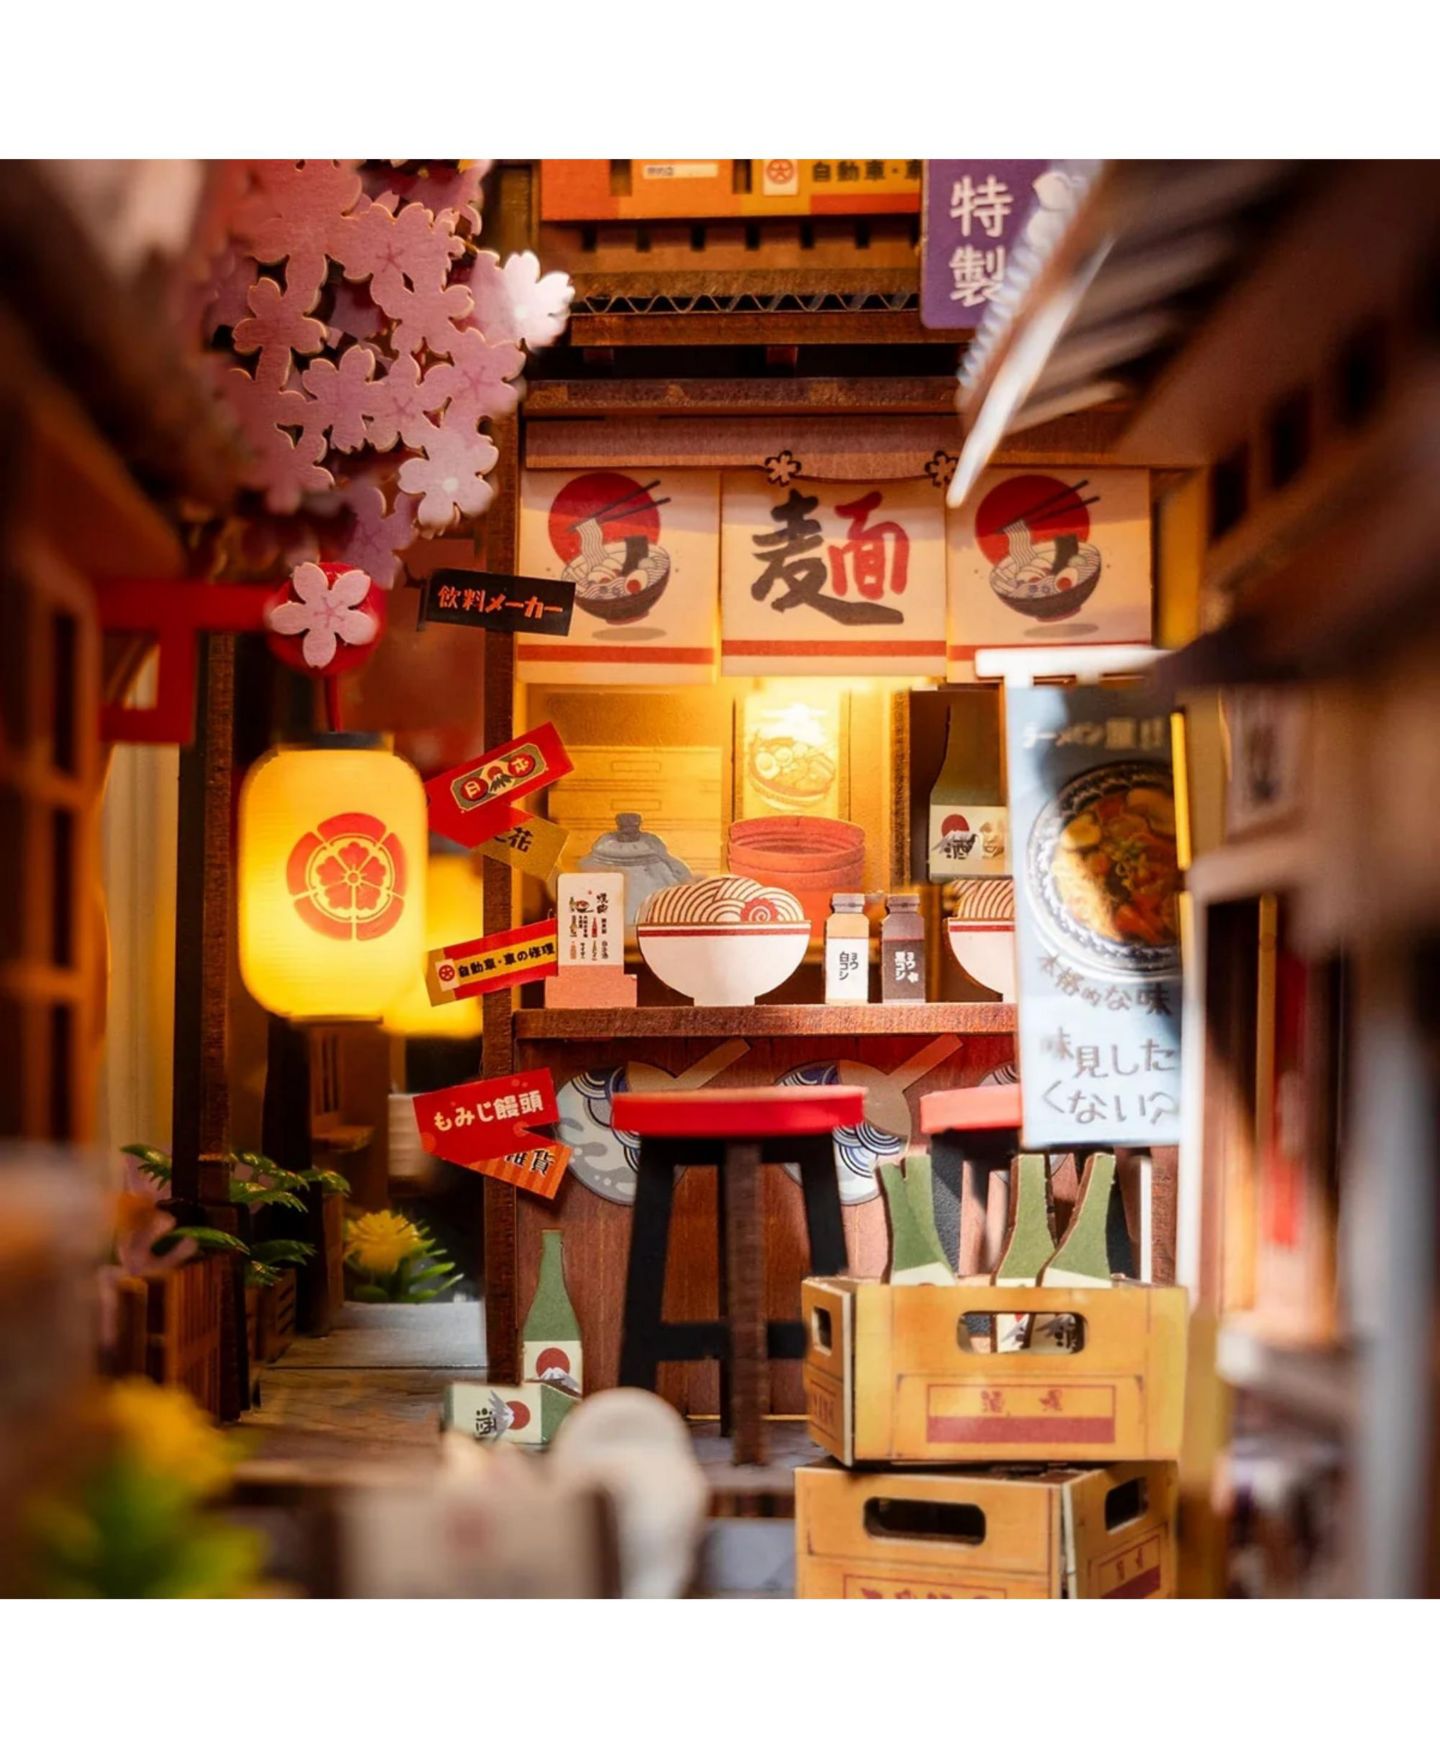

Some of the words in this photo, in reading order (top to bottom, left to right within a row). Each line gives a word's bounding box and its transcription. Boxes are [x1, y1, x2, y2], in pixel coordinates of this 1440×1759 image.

[949, 174, 1014, 307] 特製
[751, 488, 910, 625] 麺
[438, 585, 563, 619] 飲料メーカー
[494, 826, 534, 853] 花
[458, 942, 555, 978] 自動車・車の修理
[434, 1089, 544, 1132] もみじ饅頭
